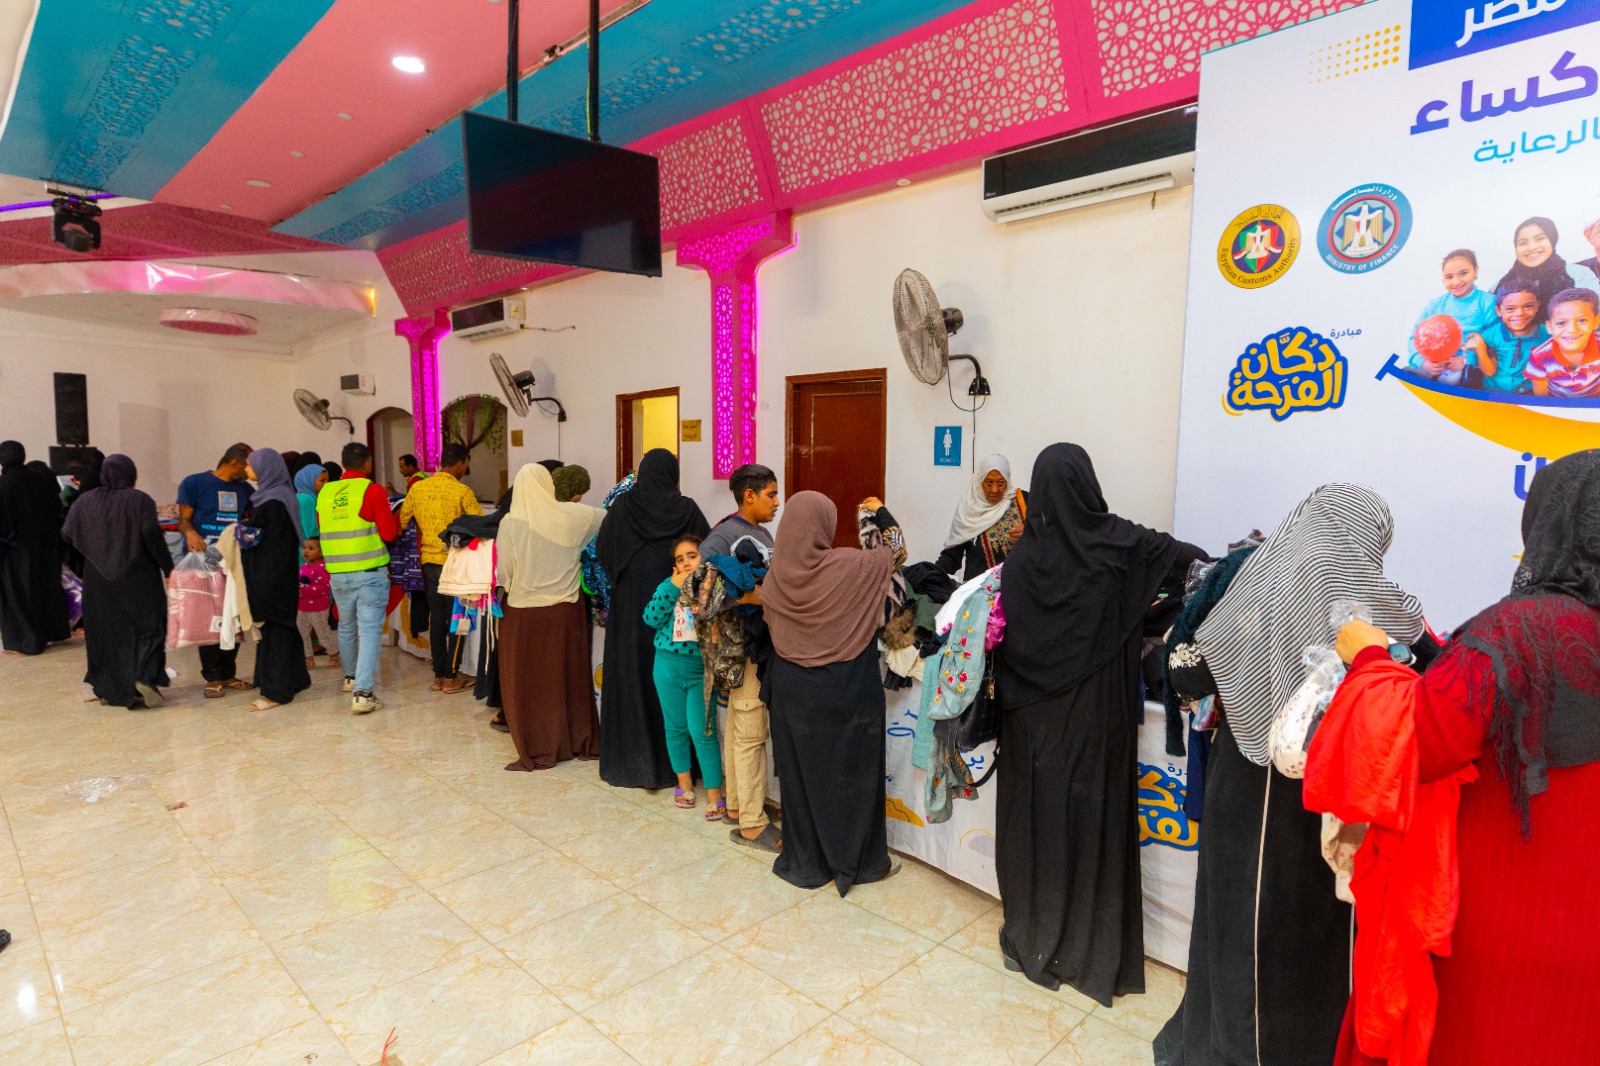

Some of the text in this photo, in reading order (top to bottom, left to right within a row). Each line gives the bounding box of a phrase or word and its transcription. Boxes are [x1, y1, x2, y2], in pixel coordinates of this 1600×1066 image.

[1410, 50, 1599, 135] كساء
[1222, 236, 1299, 285] Egyptian Customs Authority
[1326, 243, 1400, 271] MINISTRY OF FINANCE
[1329, 328, 1362, 339] مبادرة
